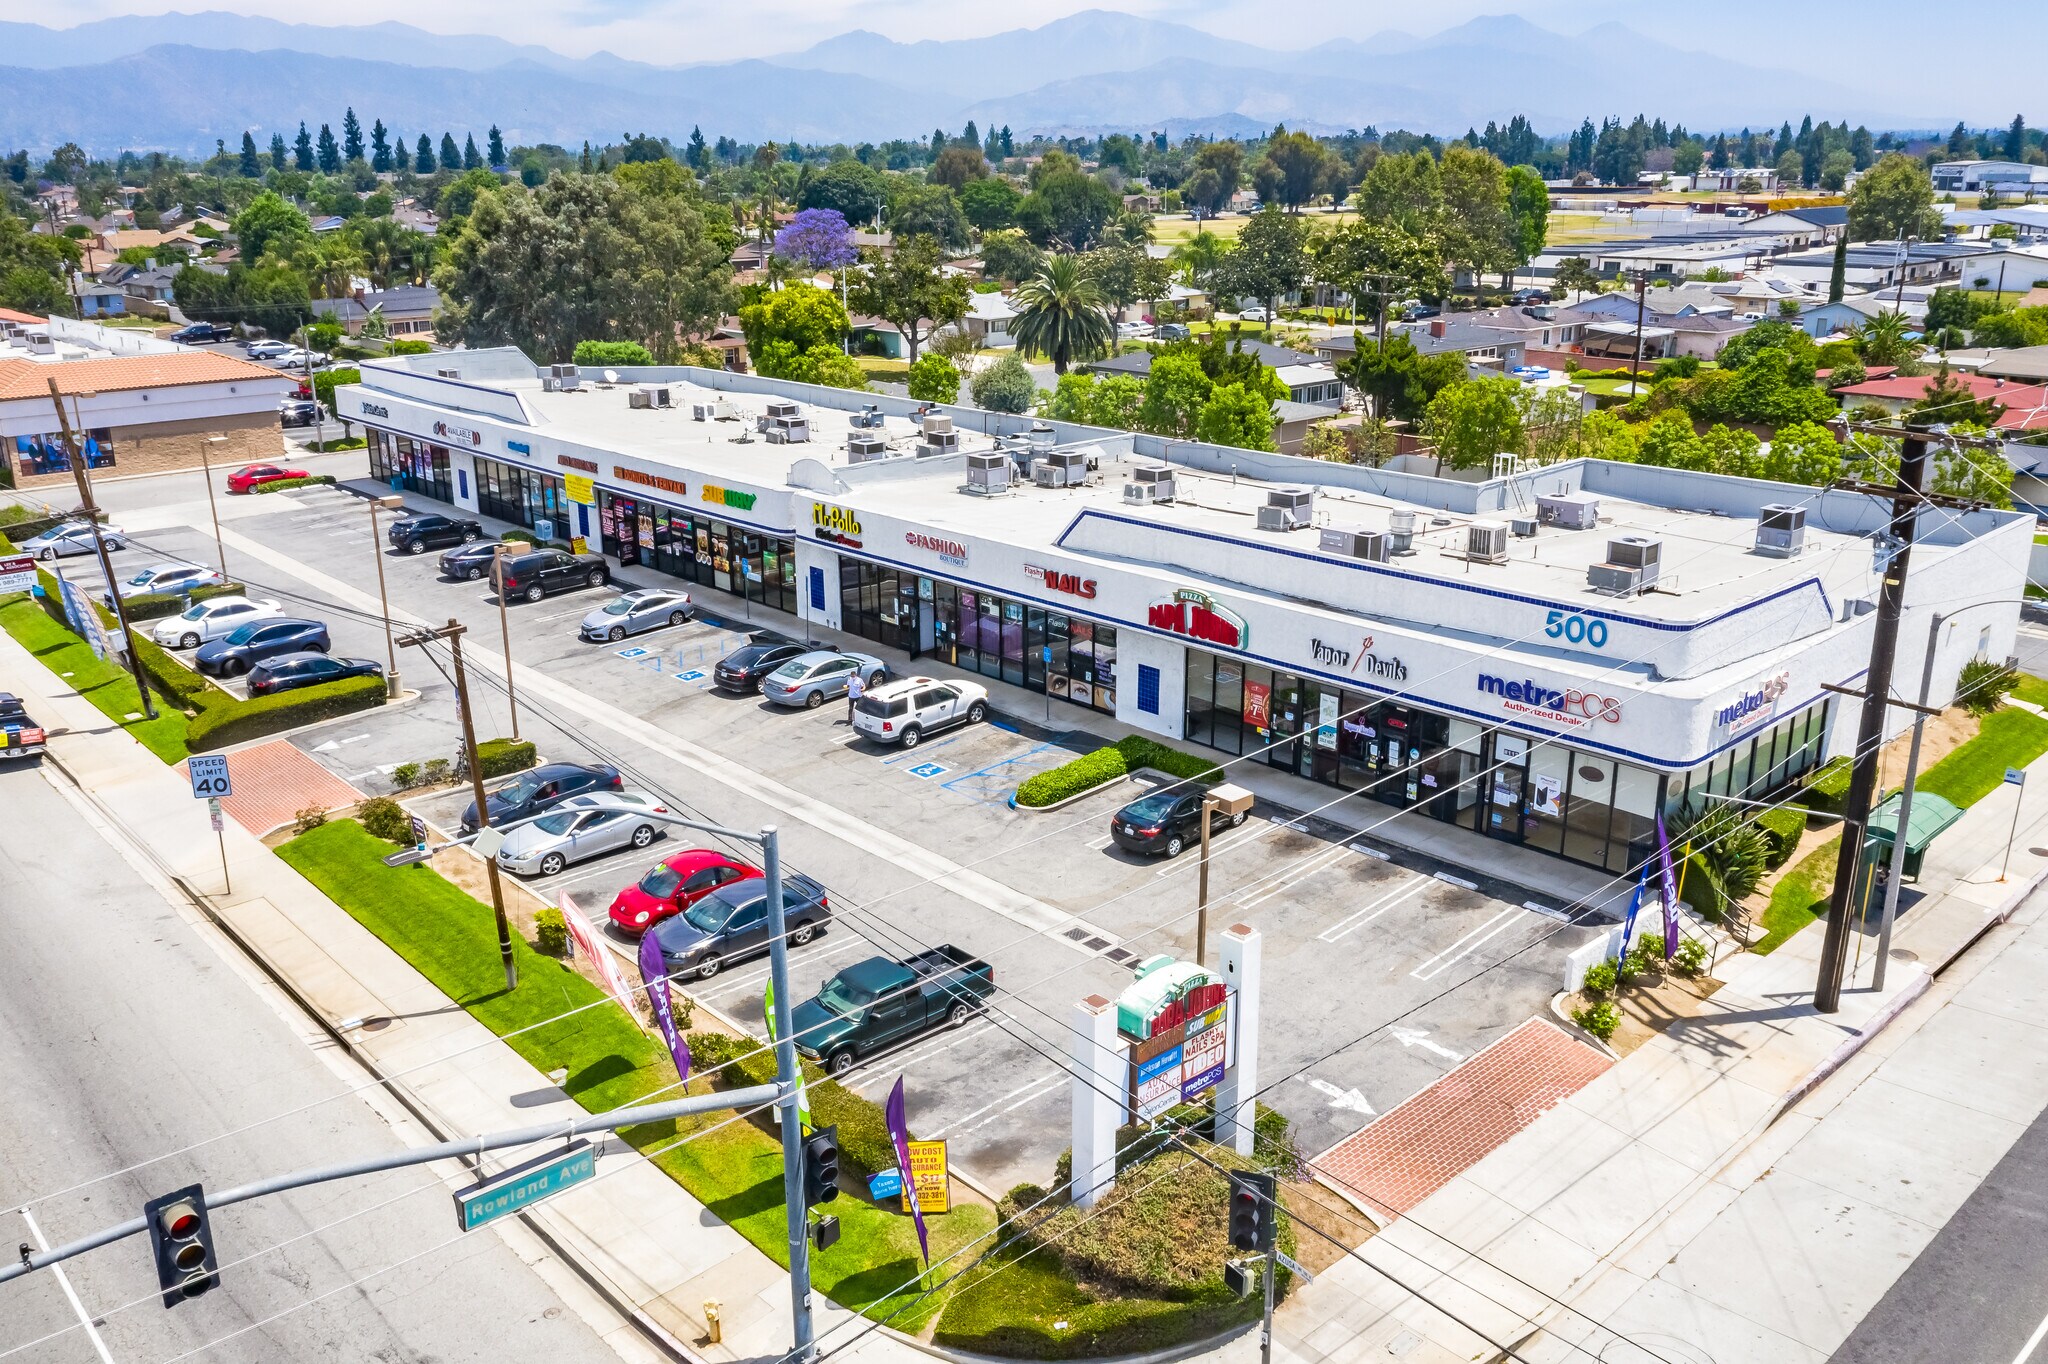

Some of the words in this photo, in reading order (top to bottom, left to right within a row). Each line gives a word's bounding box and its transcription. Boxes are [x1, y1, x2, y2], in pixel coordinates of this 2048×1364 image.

[447, 427, 472, 439] AVAILABLE
[623, 469, 649, 485] DONUTS
[656, 476, 687, 495] TERIYAKI
[702, 485, 757, 511] SUBWAY
[831, 506, 862, 535] Pollo
[917, 534, 966, 558] FASHION
[940, 554, 966, 566] BOUTIQUE
[1024, 566, 1043, 578] Flashy
[1045, 570, 1097, 599] NAILS
[1180, 591, 1204, 604] PIZZA
[1048, 618, 1069, 631] Flashy
[1148, 603, 1186, 634] PAPA
[1545, 610, 1608, 648] 500
[1310, 638, 1350, 666] Vapor
[1366, 653, 1407, 682] Devils
[1477, 673, 1622, 723] metroPCS
[1718, 671, 1790, 728] metroPCS
[1555, 713, 1588, 728] Dealer
[191, 759, 225, 768] SPEED
[196, 768, 223, 777] LIMIT
[196, 777, 228, 794] 40
[1183, 976, 1204, 992] PIZZA
[1151, 998, 1185, 1037] PAPA
[1186, 1004, 1227, 1036] SUBWAY
[1185, 1039, 1208, 1059] NAILS
[1211, 1030, 1225, 1045] SPA
[1191, 1027, 1219, 1046] FLASHY
[1184, 1045, 1224, 1081] VIDEO
[1139, 1075, 1181, 1103] NSURANCE
[1147, 1072, 1168, 1090] AUTO
[1185, 1067, 1222, 1093] metroPCS
[909, 1148, 920, 1156] OW
[912, 1164, 942, 1172] SURANCE
[472, 1176, 548, 1219] Rowland
[559, 1160, 590, 1182] Ave
[877, 1179, 894, 1188] Taxes
